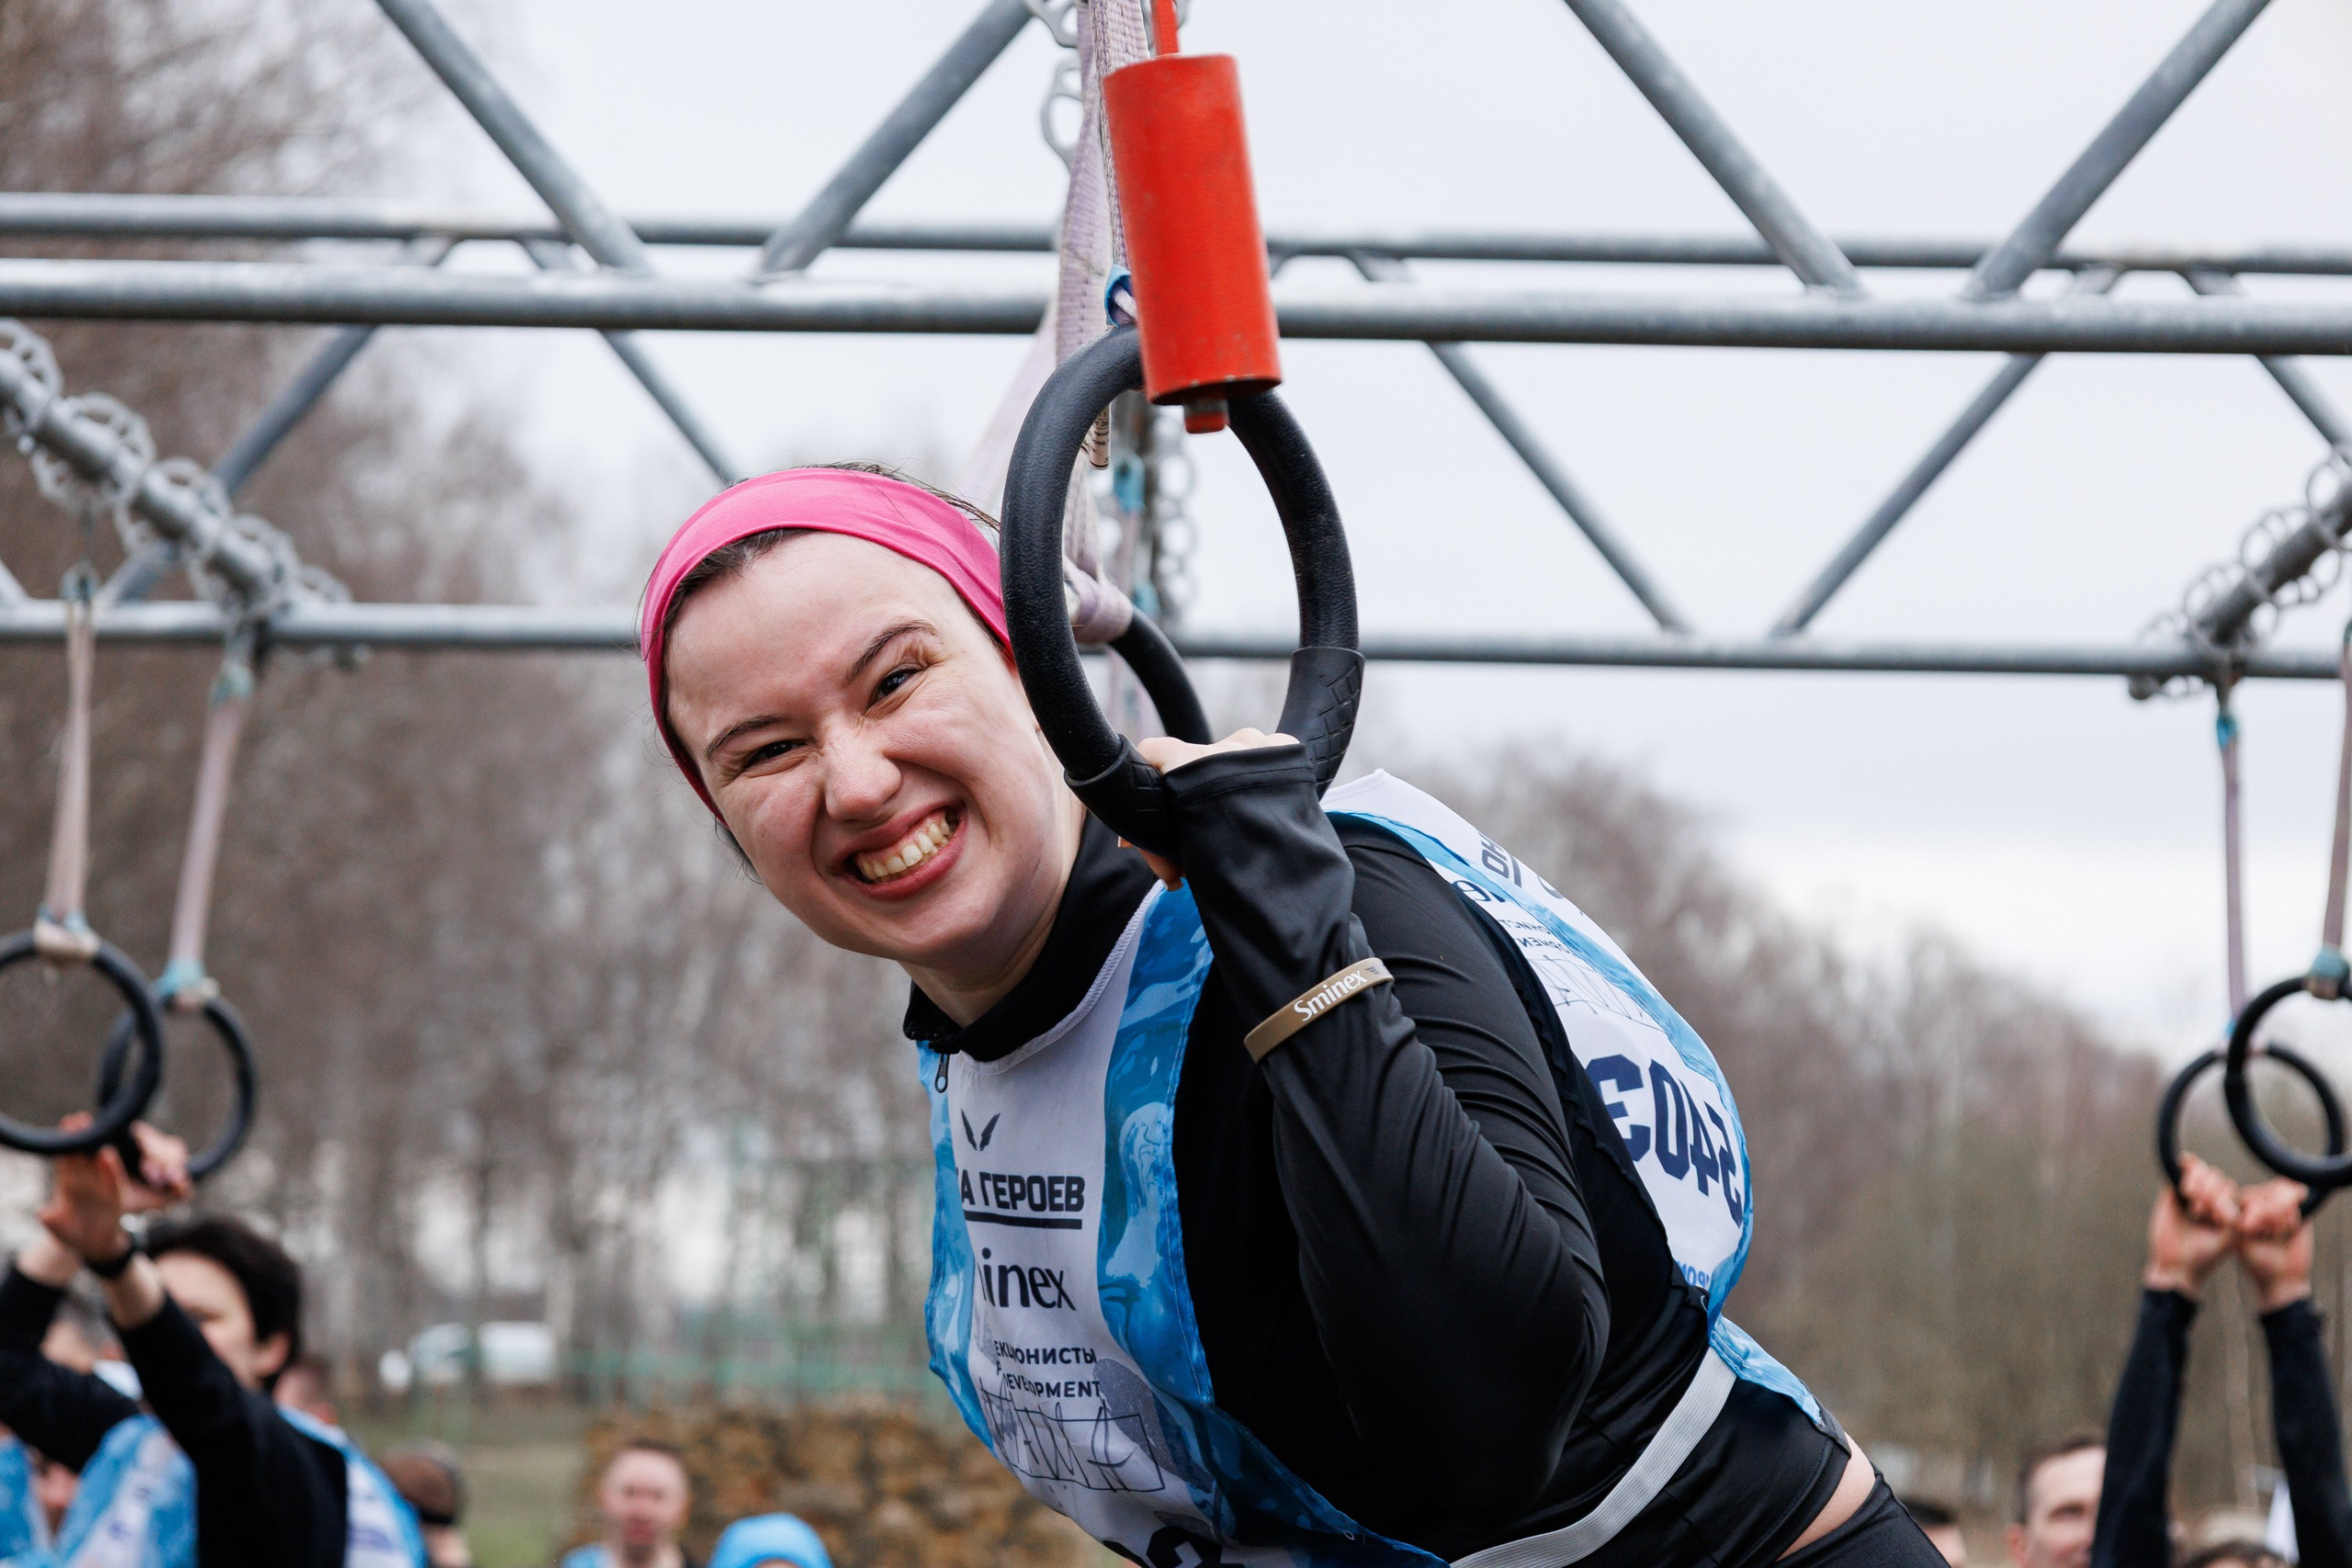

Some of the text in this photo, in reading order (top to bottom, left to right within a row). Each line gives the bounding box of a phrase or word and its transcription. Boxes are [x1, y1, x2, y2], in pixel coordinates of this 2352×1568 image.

[1294, 970, 1368, 1021] Sminex
[978, 1171, 1086, 1213] ГЕРОЕВ
[979, 1247, 1077, 1311] inex
